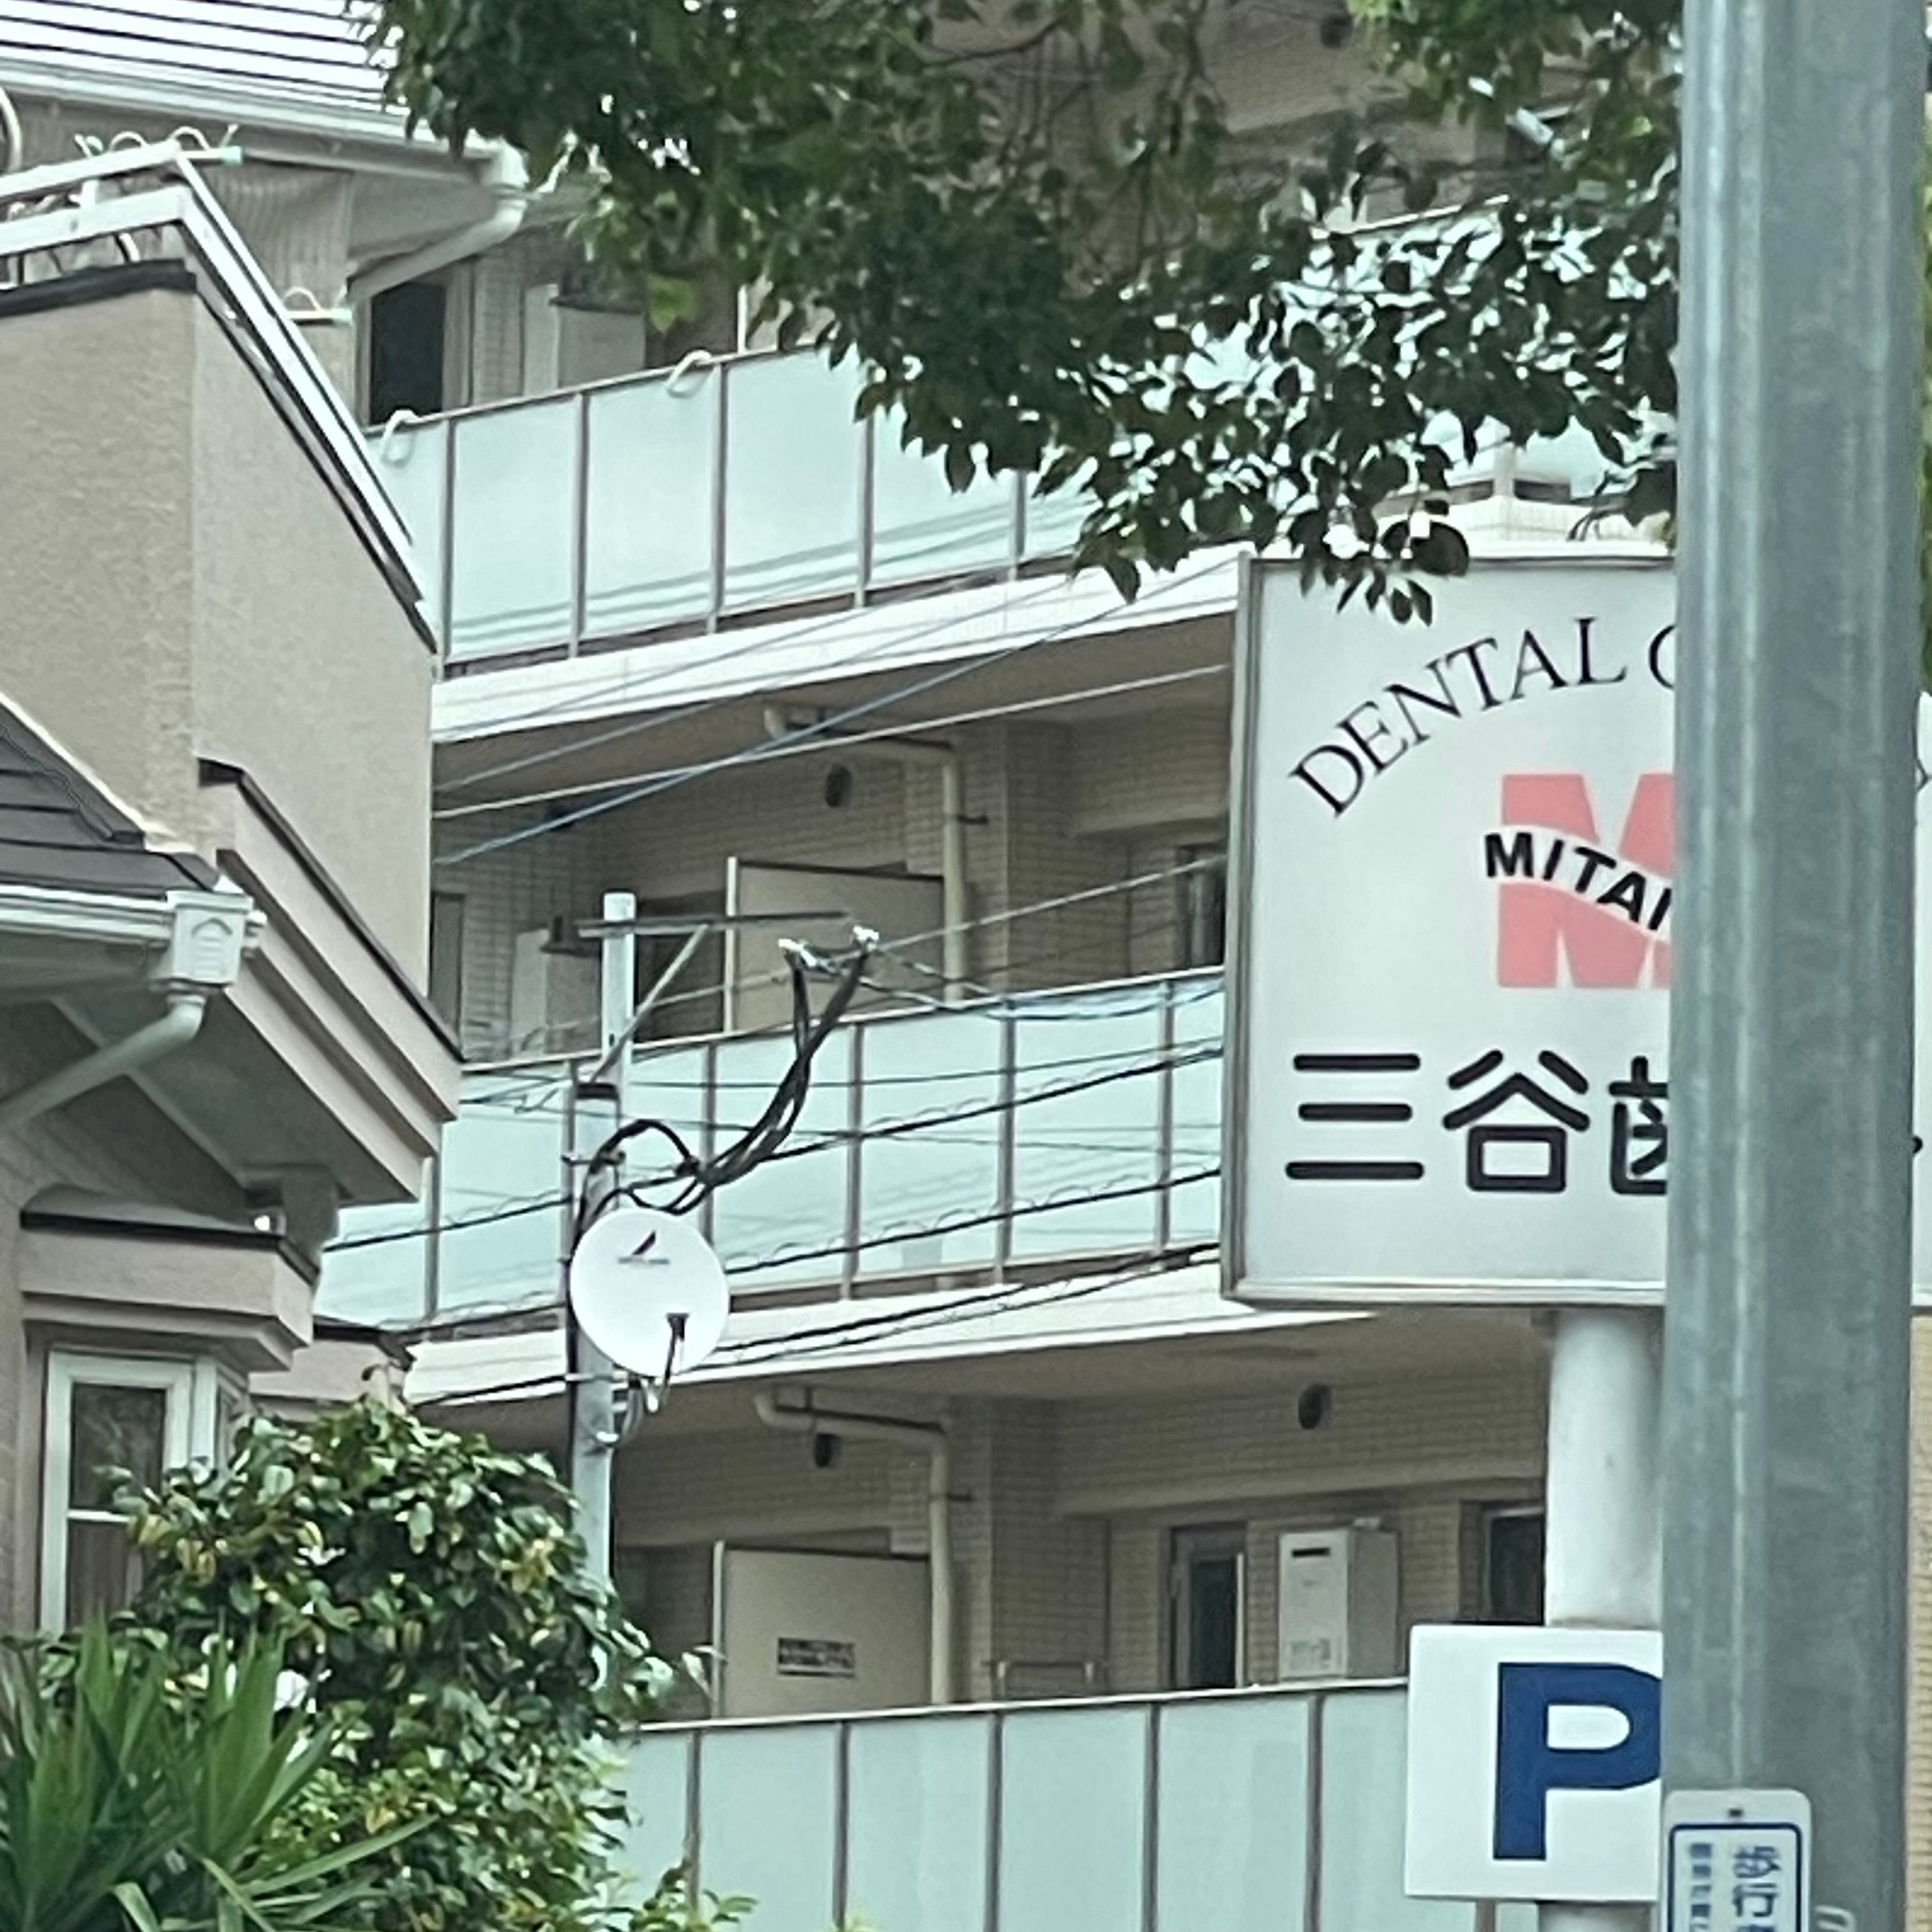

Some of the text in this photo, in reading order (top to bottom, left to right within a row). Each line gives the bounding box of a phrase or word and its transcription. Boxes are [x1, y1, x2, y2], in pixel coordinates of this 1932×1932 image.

[1289, 617, 1627, 817] DENTAL
[1493, 1662, 1660, 1860] P
[1732, 1846, 1781, 1932] 歩行
